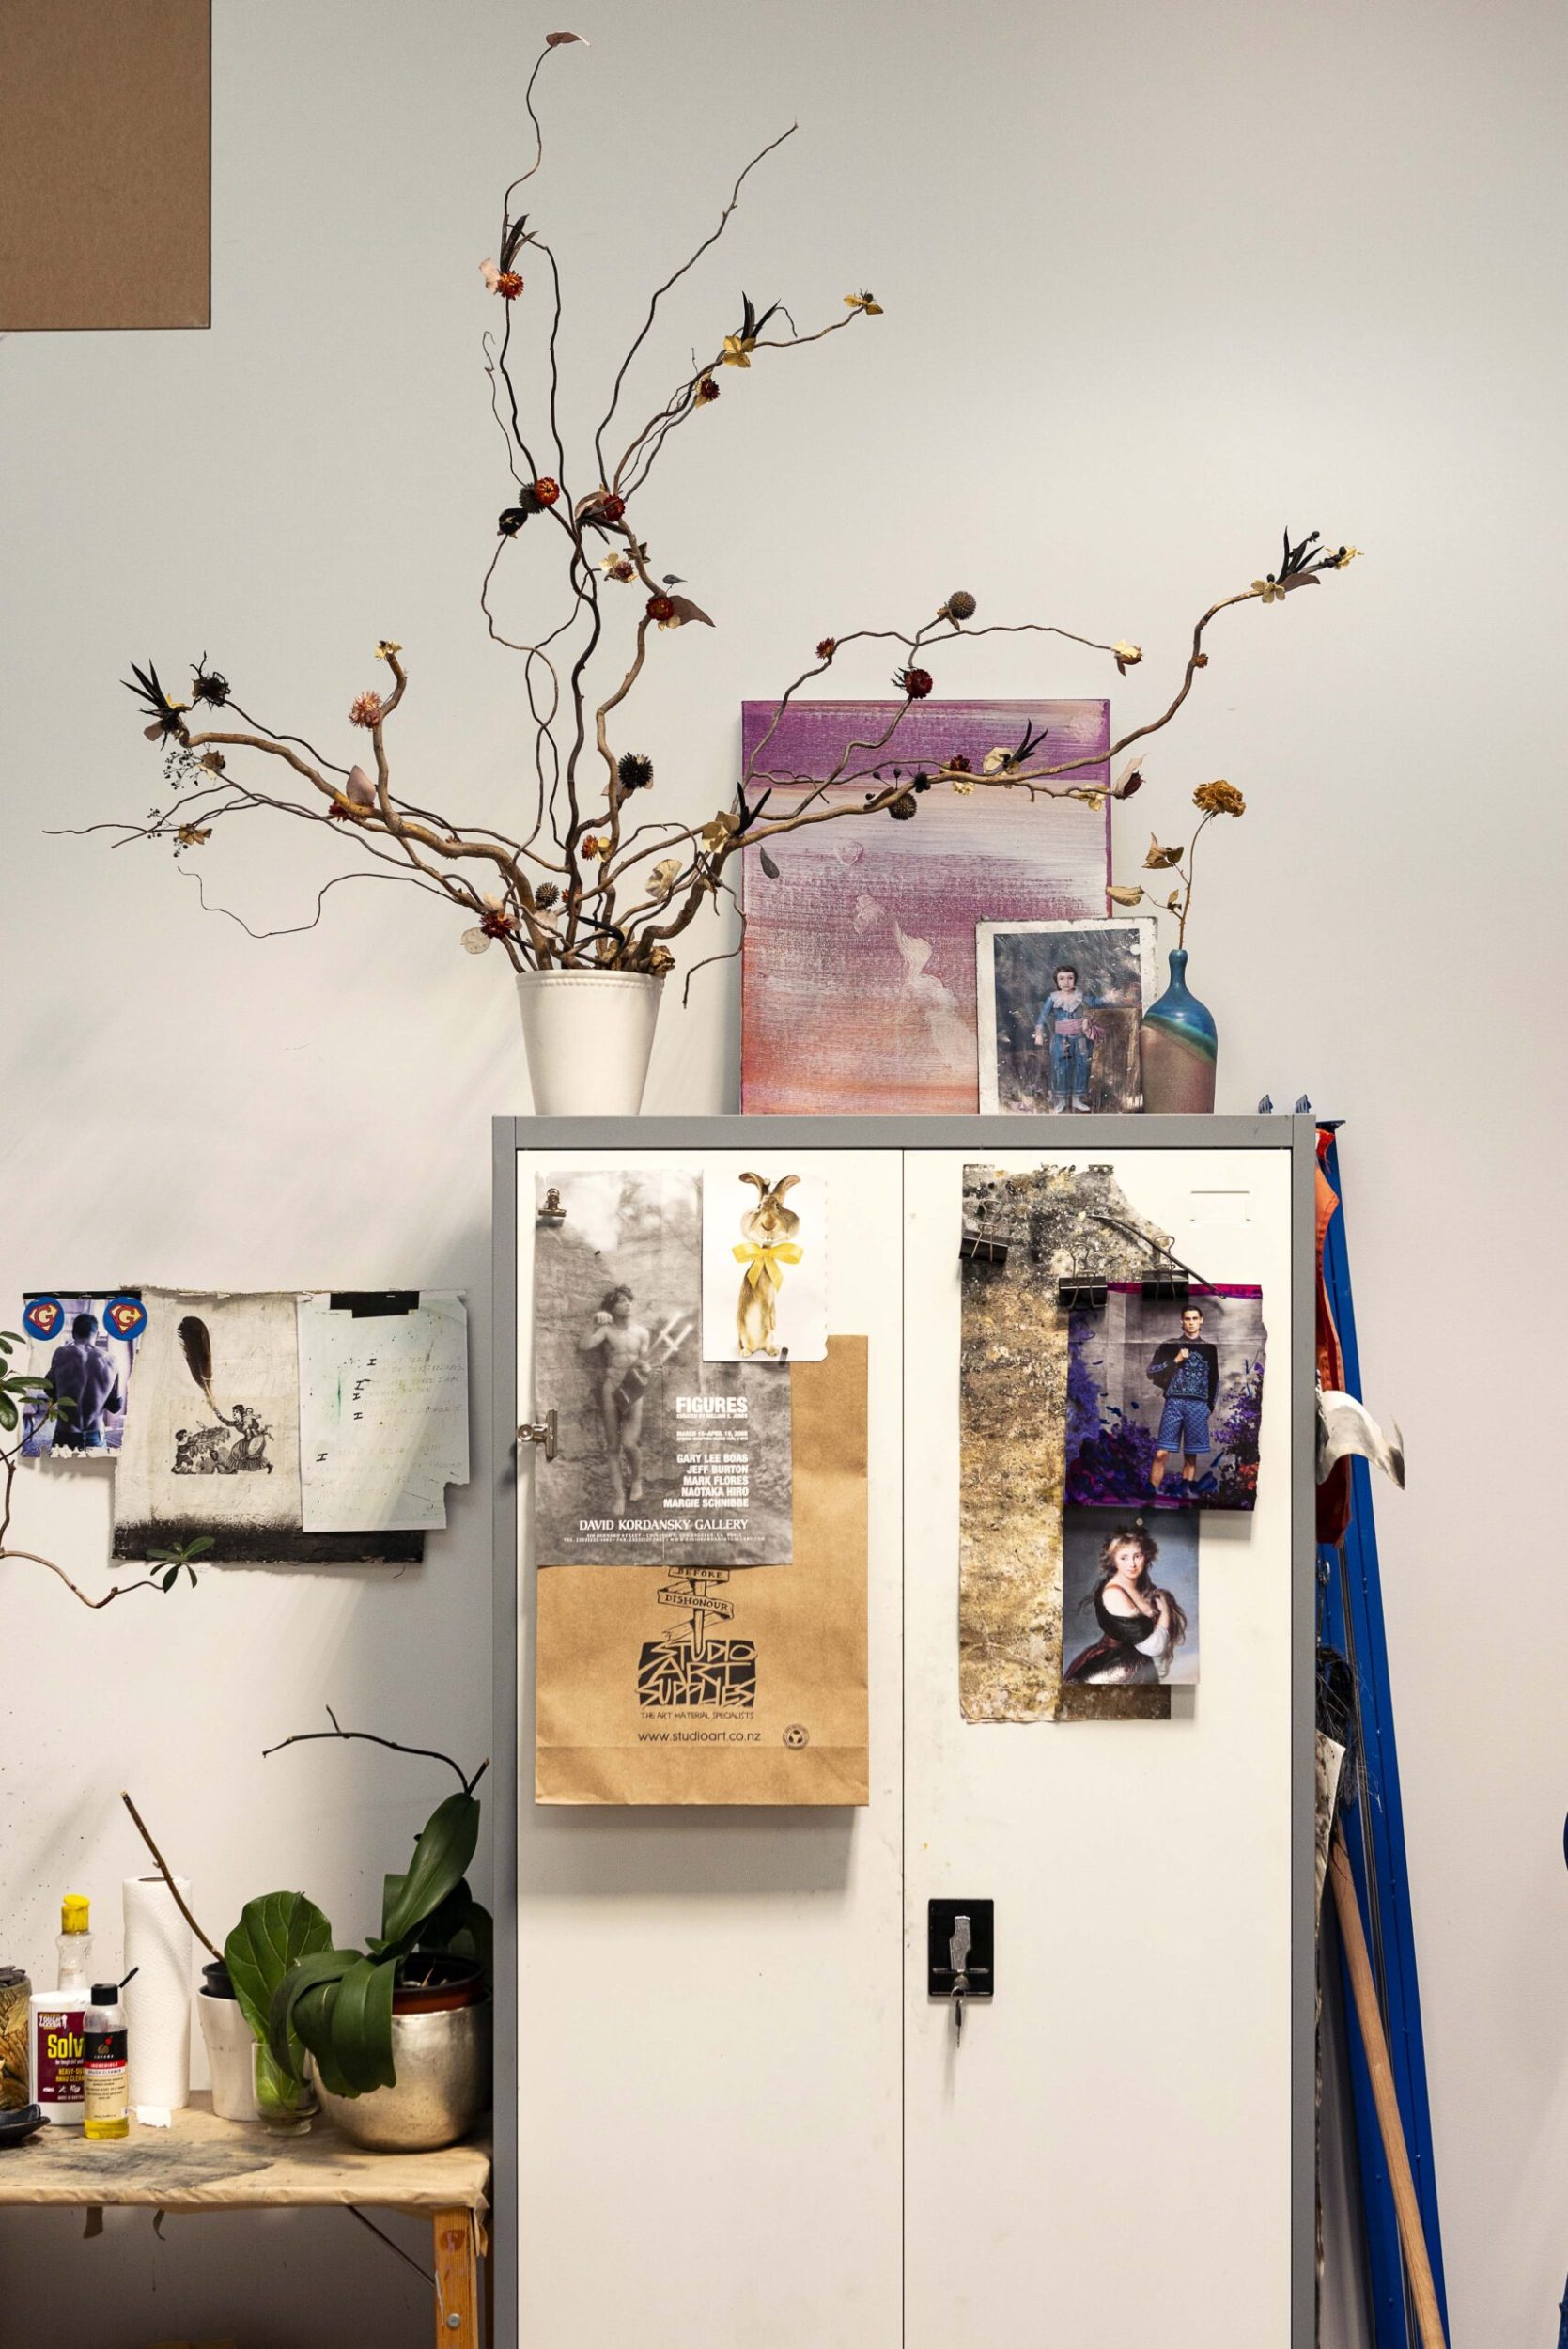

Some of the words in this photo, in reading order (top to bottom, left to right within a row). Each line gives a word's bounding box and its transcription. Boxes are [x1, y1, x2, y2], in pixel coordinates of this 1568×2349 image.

[676, 1396, 748, 1413] FIGURES
[676, 1454, 702, 1463] GARY
[704, 1454, 721, 1463] LEE
[723, 1453, 749, 1463] BOAS
[687, 1465, 709, 1474] JEFF
[711, 1465, 749, 1474] BURTON
[683, 1476, 711, 1486] MARK
[714, 1475, 749, 1486] FLORES
[681, 1487, 724, 1497] NAOTAKA
[726, 1487, 749, 1497] HIRO
[663, 1499, 700, 1508] MARGIE
[702, 1499, 749, 1508] SCHNIBBE
[579, 1520, 614, 1531] DAVID
[618, 1519, 691, 1531] KORDANSKY
[694, 1519, 749, 1530] GALLERY
[677, 1568, 723, 1579] BEFORE
[665, 1595, 729, 1610] DISHONOUR
[640, 1638, 758, 1672] STUDIO
[647, 1657, 752, 1688] ART
[635, 1676, 757, 1710] SUPPLIES
[712, 1711, 754, 1720] SPECIALISTS
[638, 1732, 761, 1742] www.studioart.co.nz
[48, 2032, 84, 2058] Solv
